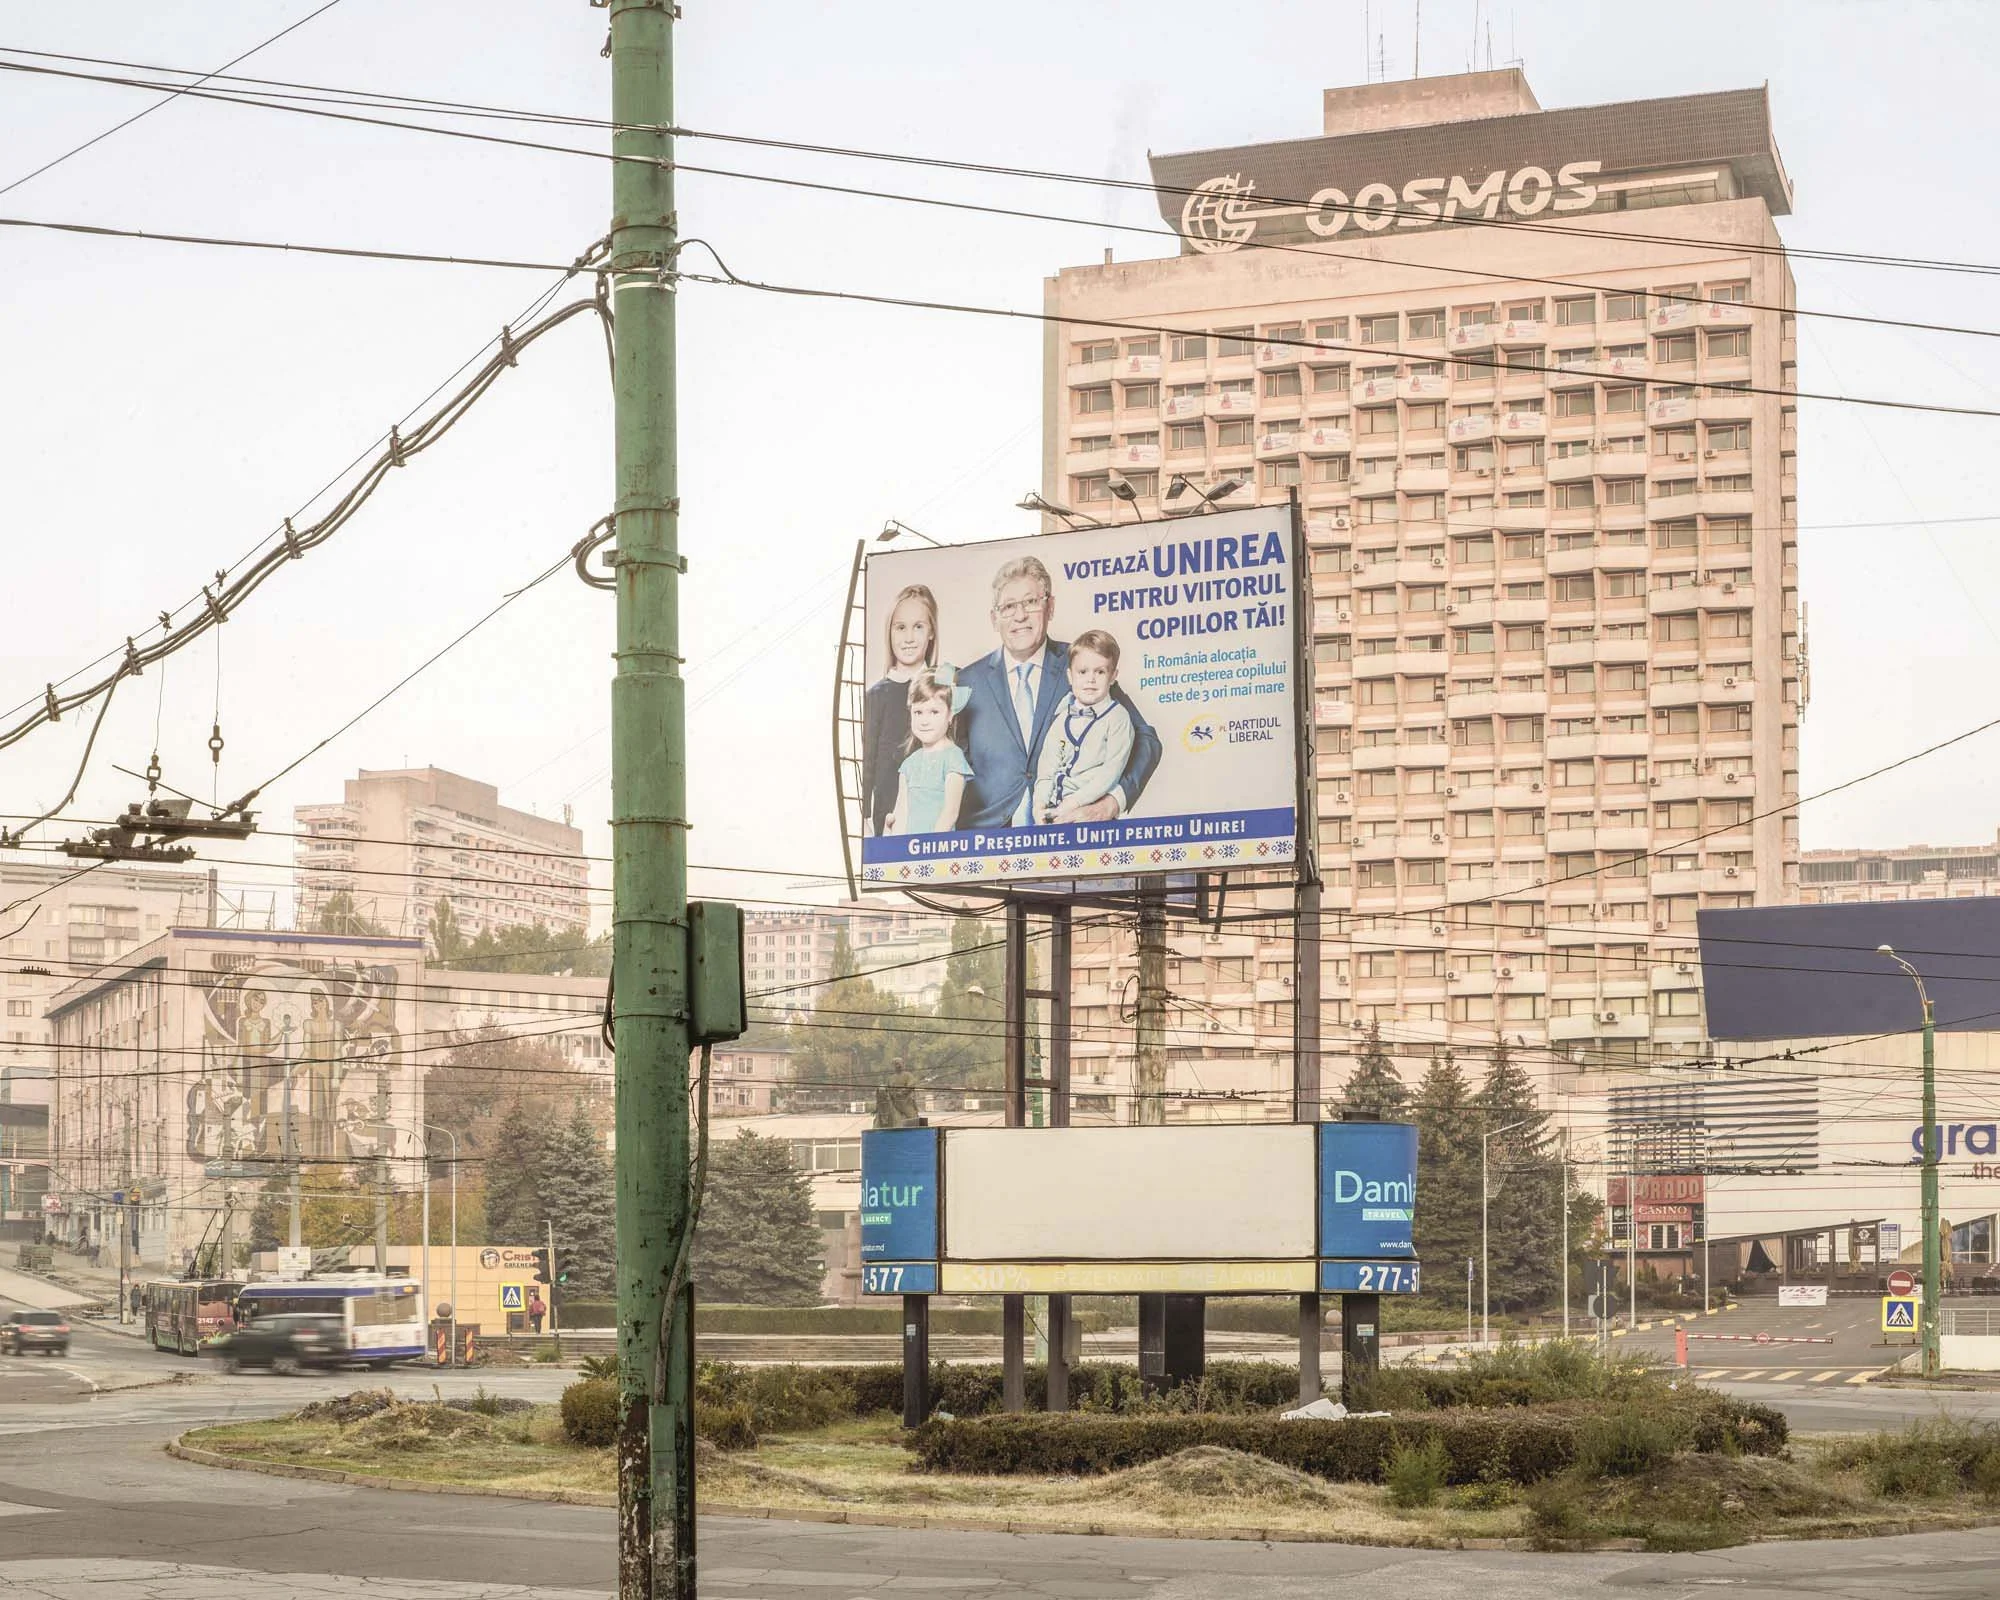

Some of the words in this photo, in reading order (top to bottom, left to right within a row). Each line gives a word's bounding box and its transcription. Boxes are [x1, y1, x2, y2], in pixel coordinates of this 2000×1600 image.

[1305, 161, 1602, 237] COSMOS
[1063, 549, 1149, 580] VOTEAZĂ
[1153, 531, 1286, 578] UNIREA
[1094, 584, 1178, 613] PENTRU
[1183, 573, 1286, 604] VIITORUL
[1137, 610, 1238, 641] COPIILOR
[1243, 601, 1285, 629] TĂI!
[1143, 655, 1155, 669] În
[1157, 651, 1208, 669] România
[1210, 646, 1257, 664] alocația
[1140, 674, 1178, 690] pentru
[1180, 668, 1233, 685] creșterea
[1236, 661, 1287, 681] copilului
[1158, 691, 1183, 704] este
[1185, 687, 1200, 701] de
[1202, 690, 1210, 702] 3
[1212, 685, 1228, 699] ori
[1230, 683, 1252, 697] mai
[1255, 682, 1285, 695] mare
[1229, 717, 1281, 731] PARTIDUL
[1229, 730, 1273, 744] LIBERAL
[1125, 824, 1183, 840] PENTRU
[1639, 1205, 1687, 1215] CASINO
[862, 1267, 904, 1292] -577
[1359, 1265, 1420, 1292] 277-5
